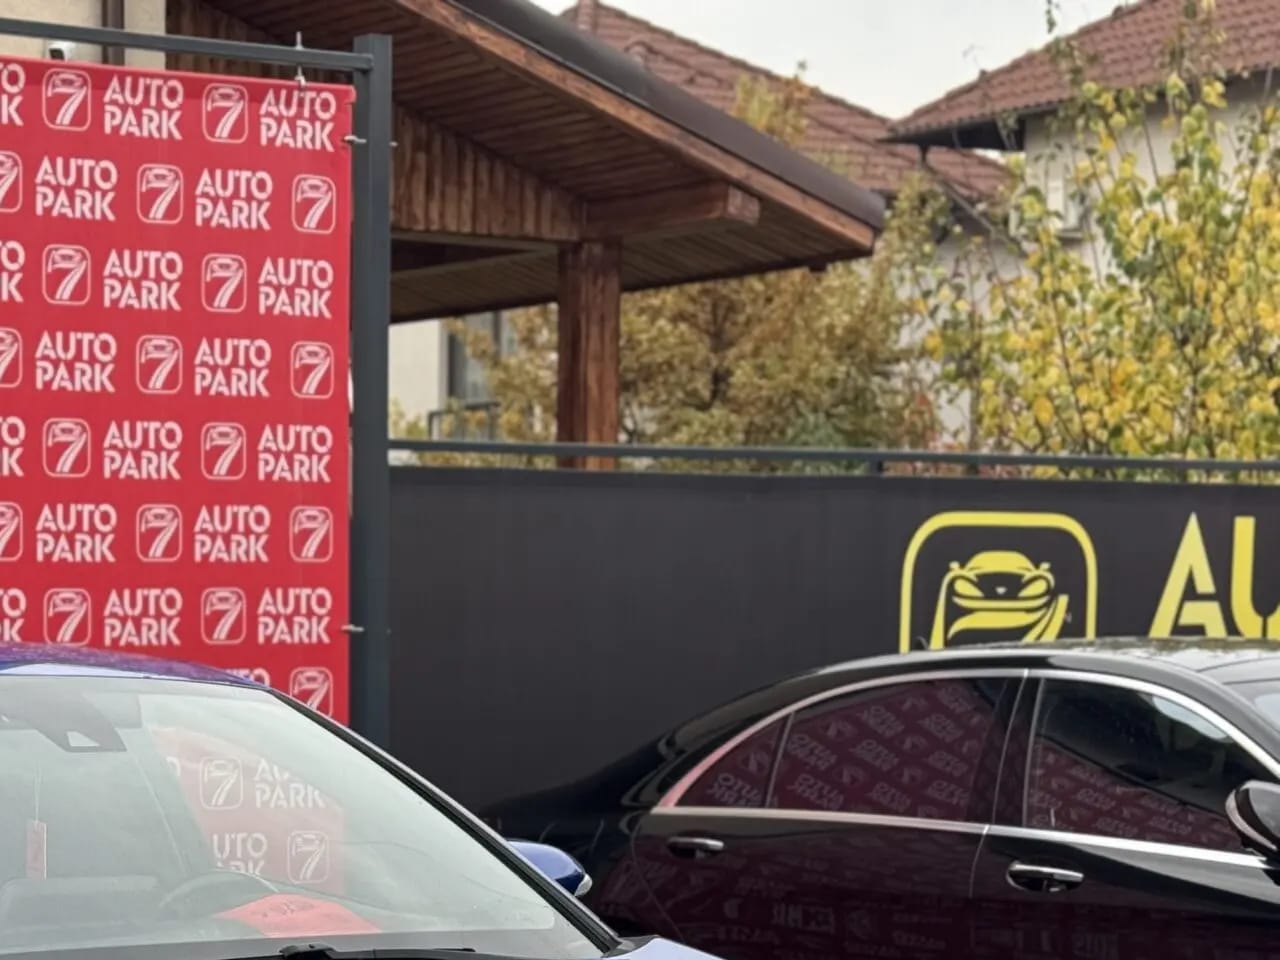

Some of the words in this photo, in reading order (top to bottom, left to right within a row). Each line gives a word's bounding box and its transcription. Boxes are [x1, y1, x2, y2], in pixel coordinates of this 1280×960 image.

[104, 75, 184, 107] AUTO
[259, 88, 336, 120] AUTO
[105, 105, 182, 140] PARK
[260, 117, 334, 151] PARK
[35, 156, 118, 190] AUTO
[195, 168, 273, 199] AUTO
[35, 186, 115, 221] PARK
[195, 197, 270, 230] PARK
[103, 249, 183, 280] AUTO
[258, 257, 333, 289] AUTO
[103, 278, 180, 310] PARK
[259, 286, 331, 318] PARK
[35, 332, 117, 362] AUTO
[194, 338, 271, 369] AUTO
[36, 360, 114, 393] PARK
[195, 365, 269, 397] PARK
[104, 421, 182, 450] AUTO
[258, 424, 332, 454] AUTO
[104, 449, 180, 480] PARK
[258, 452, 330, 482] PARK
[36, 504, 117, 533] AUTO
[194, 505, 270, 534] AUTO
[37, 532, 115, 562] PARK
[194, 533, 268, 562] PARK
[103, 588, 183, 617] AUTO
[258, 588, 332, 616] AUTO
[104, 615, 181, 646] PARK
[258, 614, 329, 644] PARK
[213, 831, 268, 858] UTO
